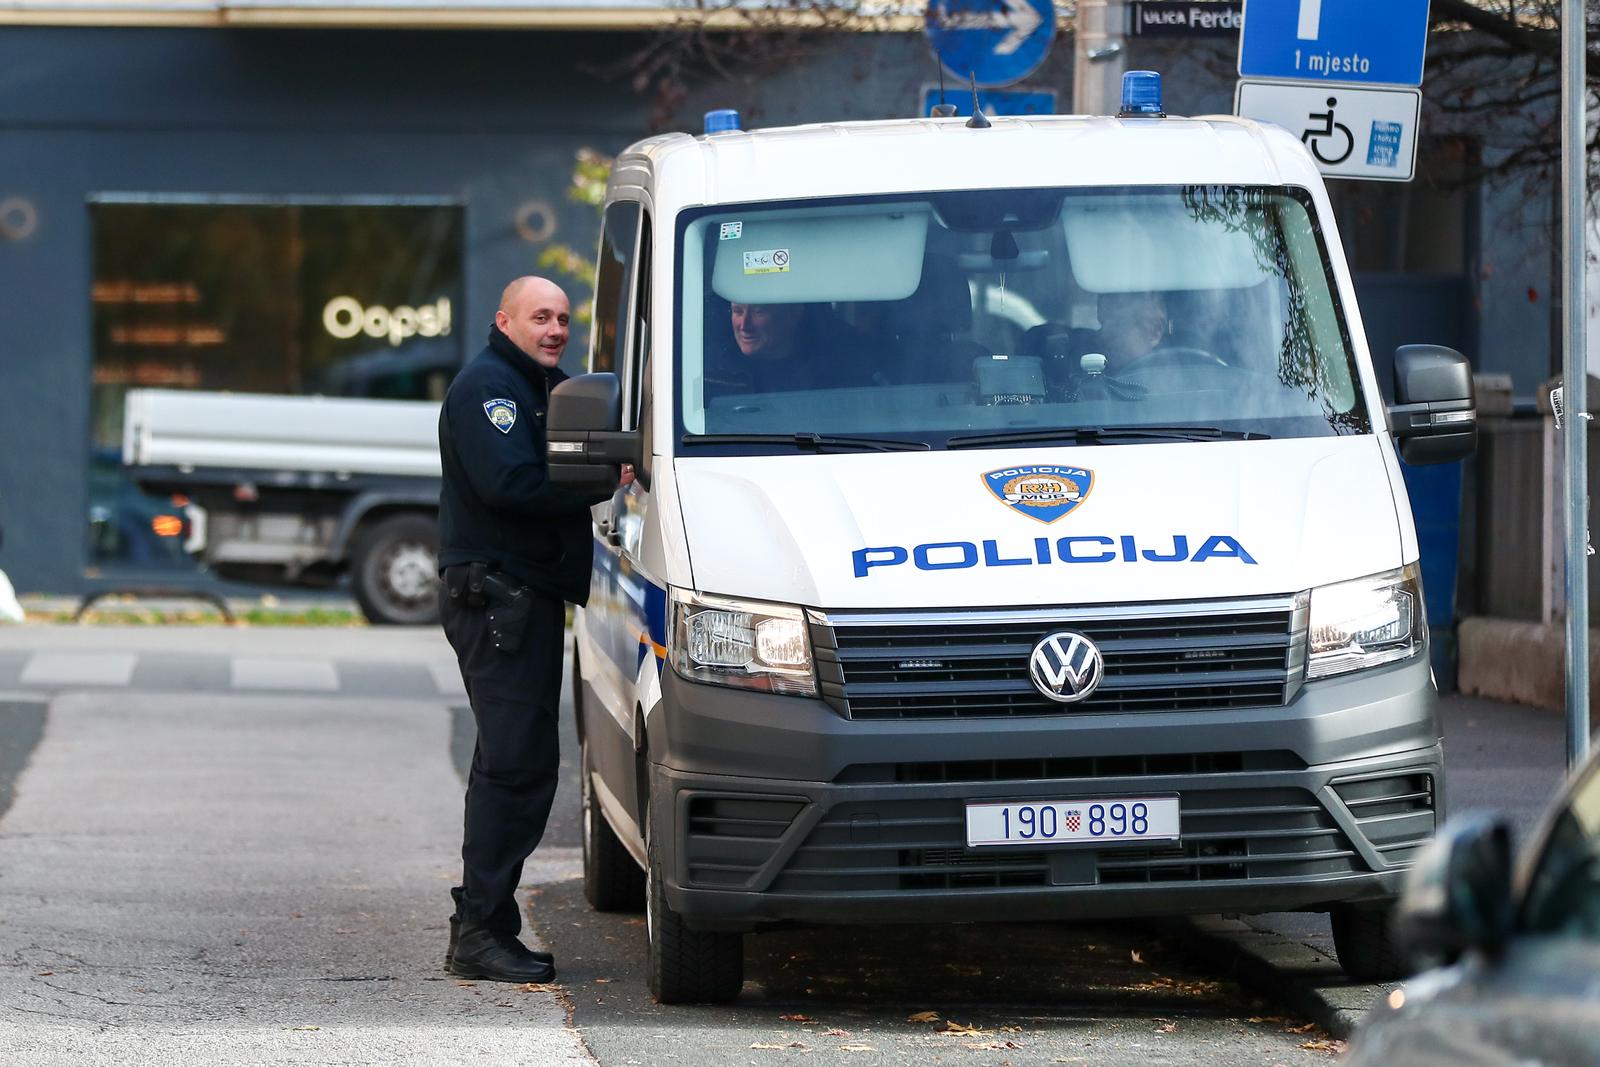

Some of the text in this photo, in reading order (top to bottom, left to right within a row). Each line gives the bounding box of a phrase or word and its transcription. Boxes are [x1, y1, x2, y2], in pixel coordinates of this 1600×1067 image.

[1143, 10, 1187, 24] ULICA
[1295, 49, 1370, 76] 1 mjesto
[322, 295, 451, 347] Oops!
[989, 466, 1087, 480] POLICIJA
[1020, 482, 1062, 494] RH
[852, 535, 1259, 578] POLICIJA
[1032, 634, 1101, 700] VW
[1002, 803, 1149, 839] 190 898
